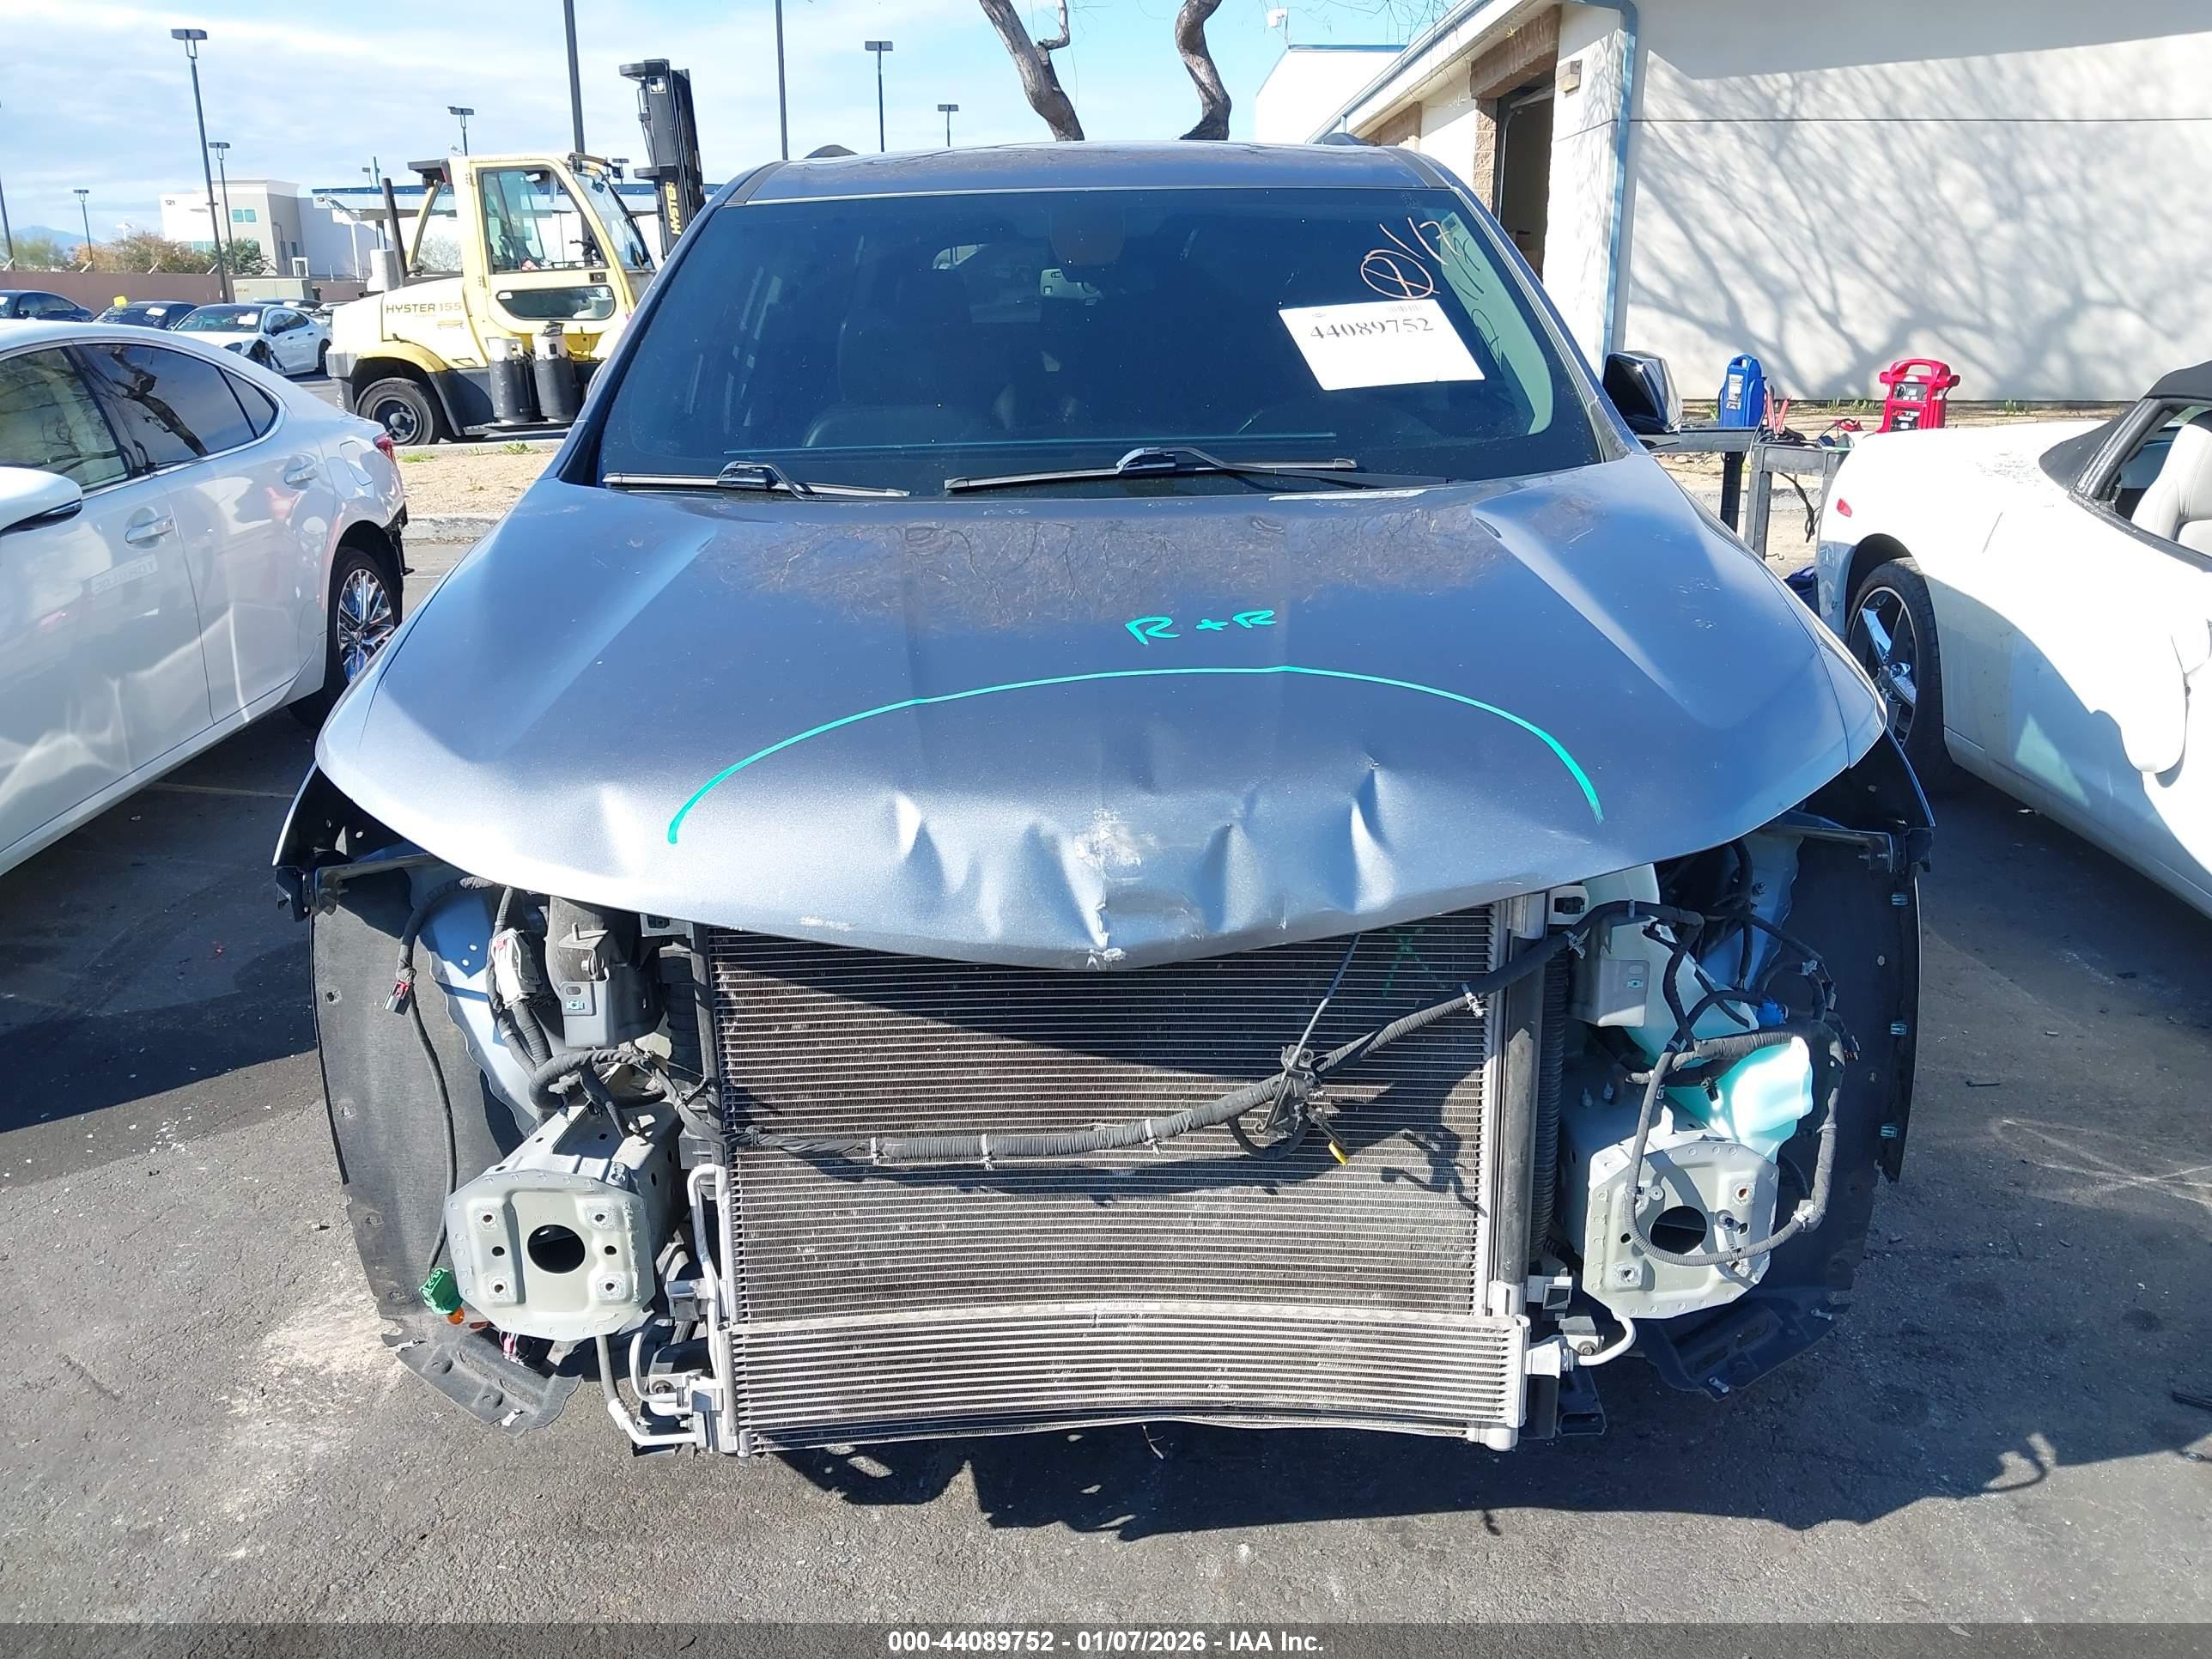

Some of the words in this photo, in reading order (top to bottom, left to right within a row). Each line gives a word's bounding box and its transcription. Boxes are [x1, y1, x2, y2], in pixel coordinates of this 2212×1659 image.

[386, 303, 436, 314] HYSTER
[439, 301, 462, 313] 155
[1310, 317, 1435, 339] 44089752
